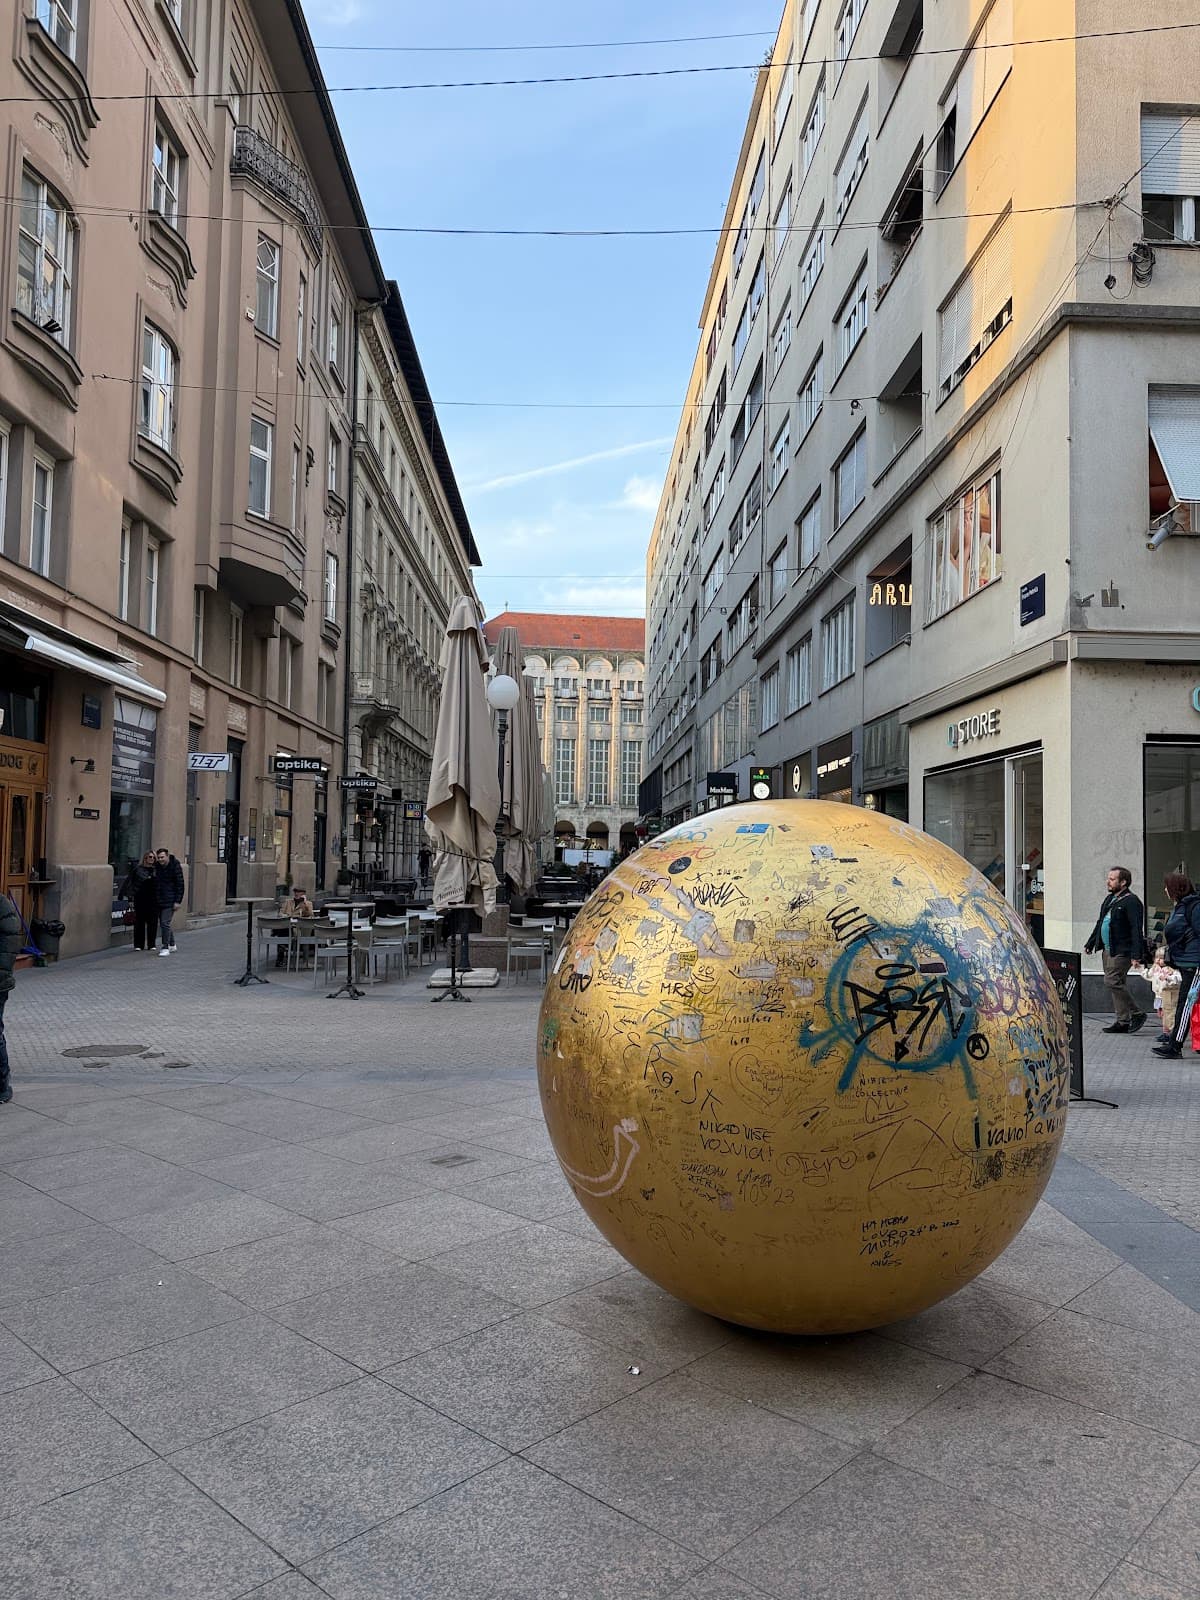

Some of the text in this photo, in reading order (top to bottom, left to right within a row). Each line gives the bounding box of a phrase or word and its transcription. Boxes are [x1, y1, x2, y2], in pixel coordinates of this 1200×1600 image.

[957, 709, 1000, 743] STORE
[276, 759, 320, 773] optika
[342, 778, 376, 788] optika
